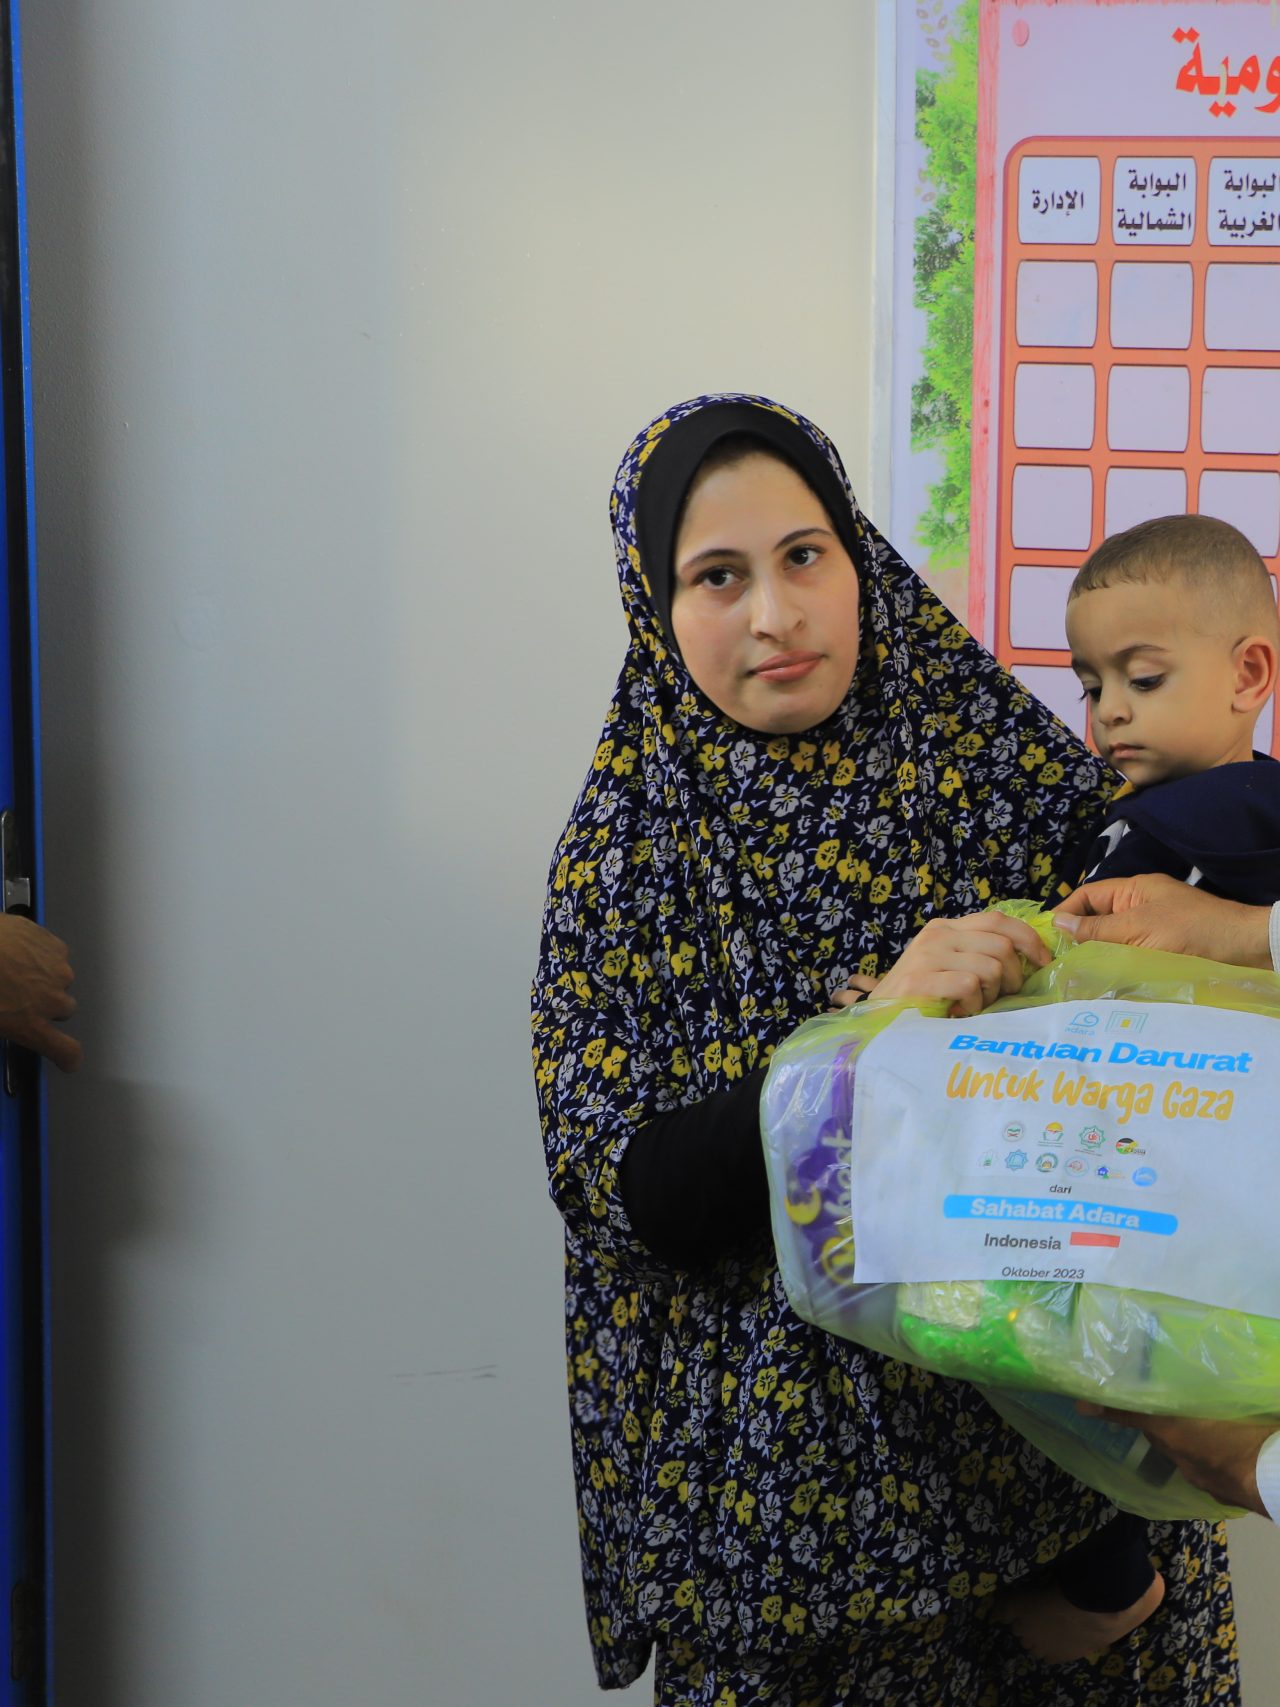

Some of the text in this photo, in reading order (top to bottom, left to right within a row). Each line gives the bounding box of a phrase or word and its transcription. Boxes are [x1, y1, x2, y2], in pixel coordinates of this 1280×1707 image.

[1128, 170, 1186, 198] البوابة
[1032, 190, 1083, 214] الإدارة
[1117, 208, 1191, 236] الشمالية
[1219, 210, 1280, 238] الغربية
[948, 1034, 1253, 1073] Bantuan Darurat
[945, 1061, 1235, 1125] Untuk Warga Gaza
[1049, 1184, 1072, 1195] dari
[970, 1197, 1140, 1228] Sahabat Adara
[983, 1233, 1062, 1251] Indonesia
[1001, 1265, 1085, 1280] Oktober 2023
